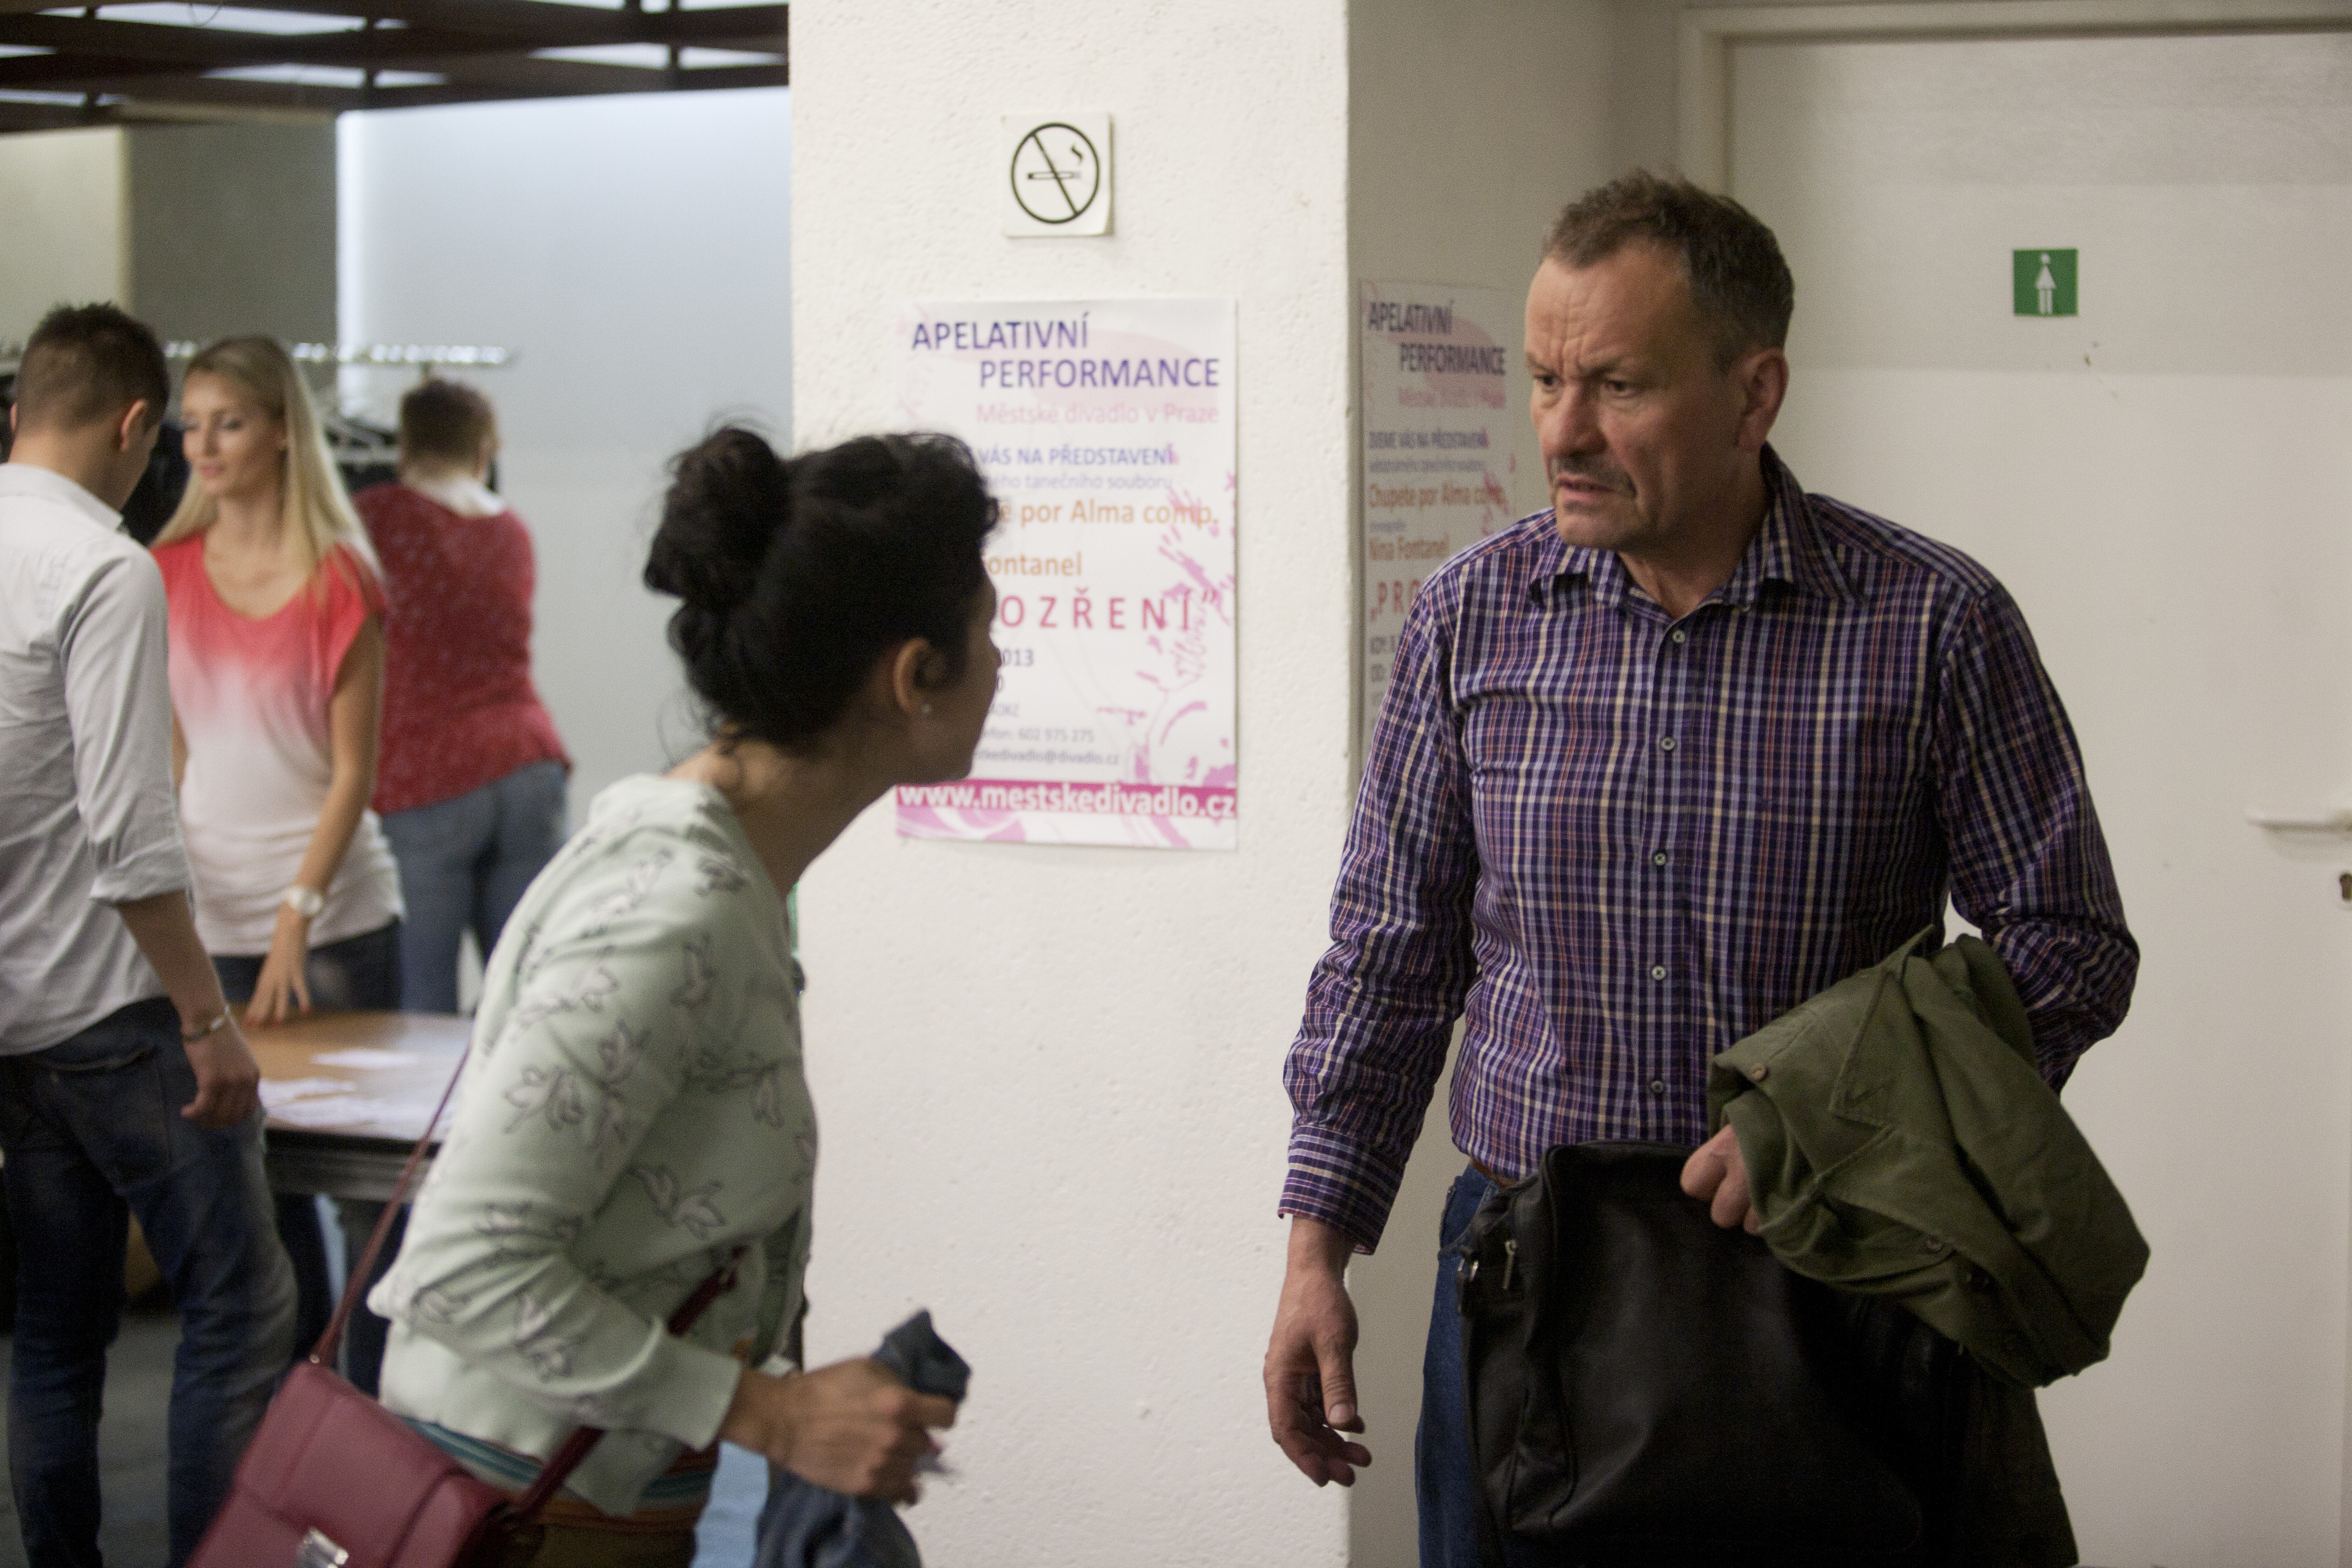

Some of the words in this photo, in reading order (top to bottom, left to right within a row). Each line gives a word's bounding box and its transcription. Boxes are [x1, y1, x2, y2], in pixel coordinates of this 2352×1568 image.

[912, 311, 1090, 350] APELATIVNÍ
[980, 358, 1220, 388] PERFORMANCE
[1400, 342, 1506, 375] PERFORMANCE
[976, 403, 1058, 424] Městské
[1065, 403, 1139, 424] divadlo
[1146, 408, 1159, 423] v
[1164, 403, 1219, 424] Praze
[978, 444, 1011, 465] VÁS
[1018, 447, 1042, 465] NA
[1048, 444, 1173, 465] PŘEDSTAVENÍ
[1020, 504, 1063, 527] por
[1070, 498, 1135, 524] Alma
[1143, 504, 1219, 529] comp.
[982, 551, 1083, 577] ontanel
[1002, 648, 1034, 667] 013
[899, 783, 1235, 817] www.mestskedivadlo.cz
